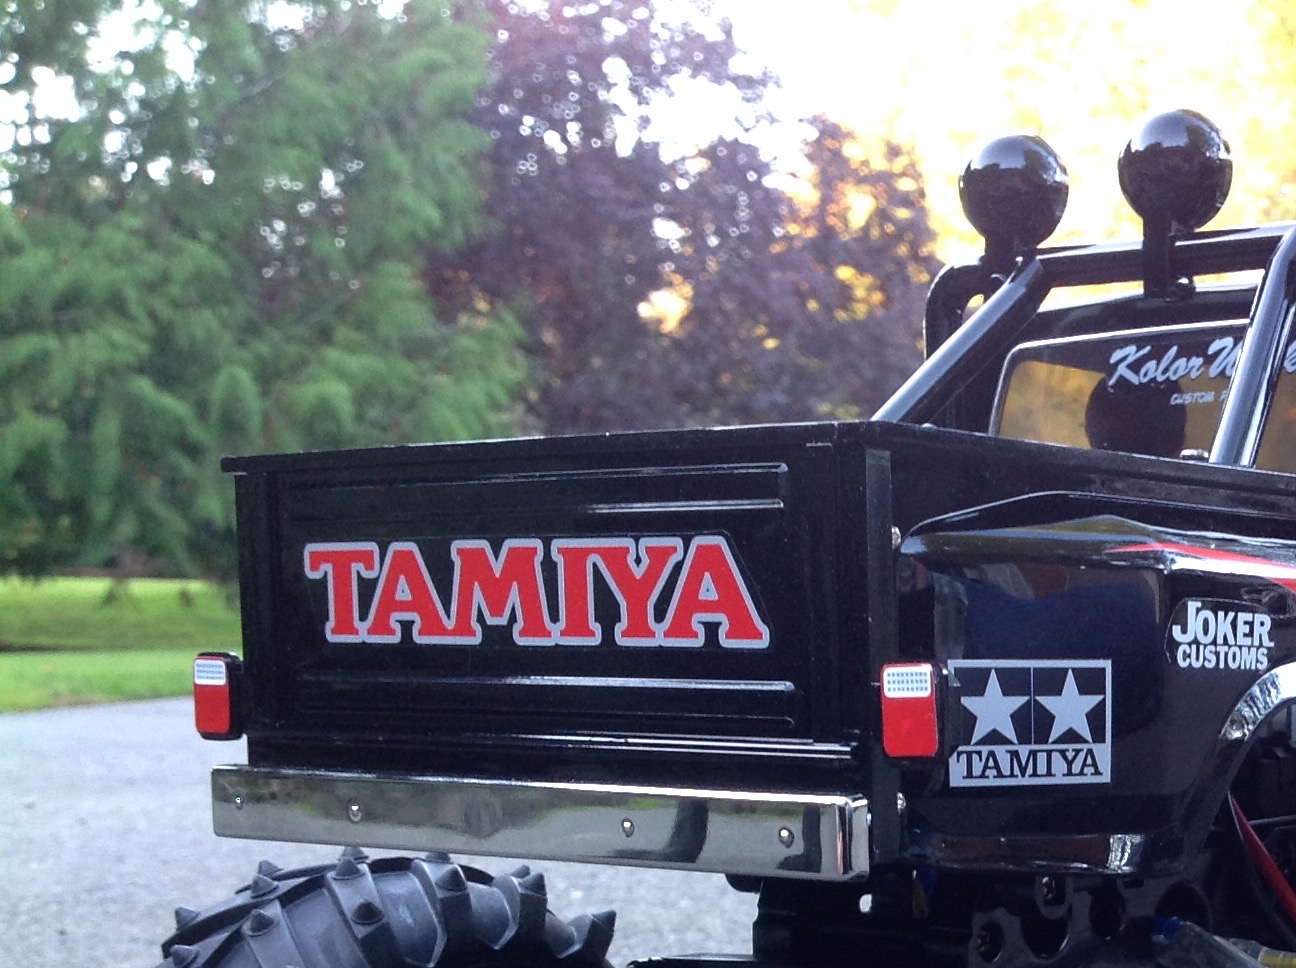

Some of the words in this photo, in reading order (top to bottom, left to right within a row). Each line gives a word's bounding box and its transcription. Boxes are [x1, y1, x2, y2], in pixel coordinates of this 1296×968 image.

[1107, 344, 1205, 386] Kolor
[303, 535, 771, 650] TAMIYA
[1172, 601, 1275, 648] JOKER
[1176, 644, 1269, 671] CUSTOMS
[956, 747, 1104, 780] TAMIYA
